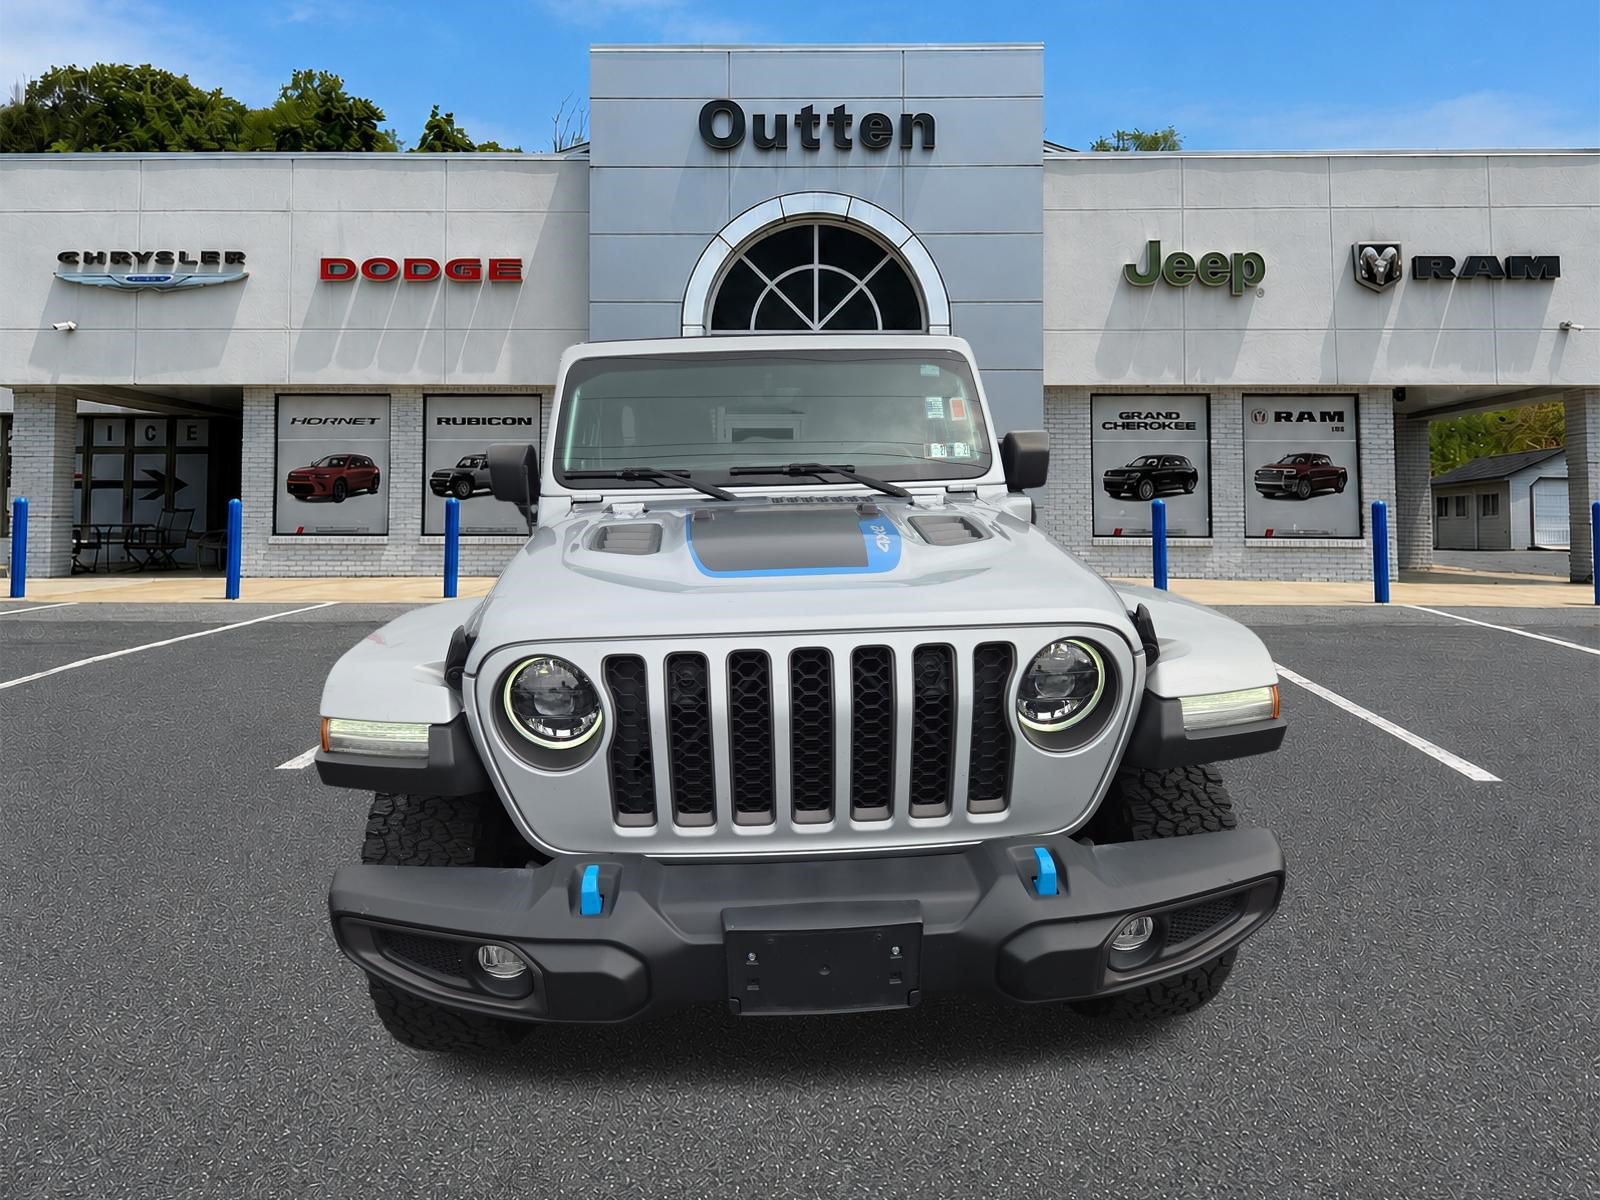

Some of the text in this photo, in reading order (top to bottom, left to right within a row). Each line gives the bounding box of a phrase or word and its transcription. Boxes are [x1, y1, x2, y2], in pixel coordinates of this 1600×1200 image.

[699, 99, 935, 149] Outten
[57, 251, 246, 266] CHRYSLER
[320, 256, 523, 282] DODGE
[1124, 239, 1266, 295] Jeep
[1411, 255, 1561, 280] RAM
[290, 417, 380, 425] HORNET
[436, 416, 532, 426] RUBICON
[1118, 411, 1181, 420] GRAND
[1274, 411, 1344, 422] RAM
[1101, 421, 1197, 431] CHEROKEE
[869, 524, 891, 553] 4xe
